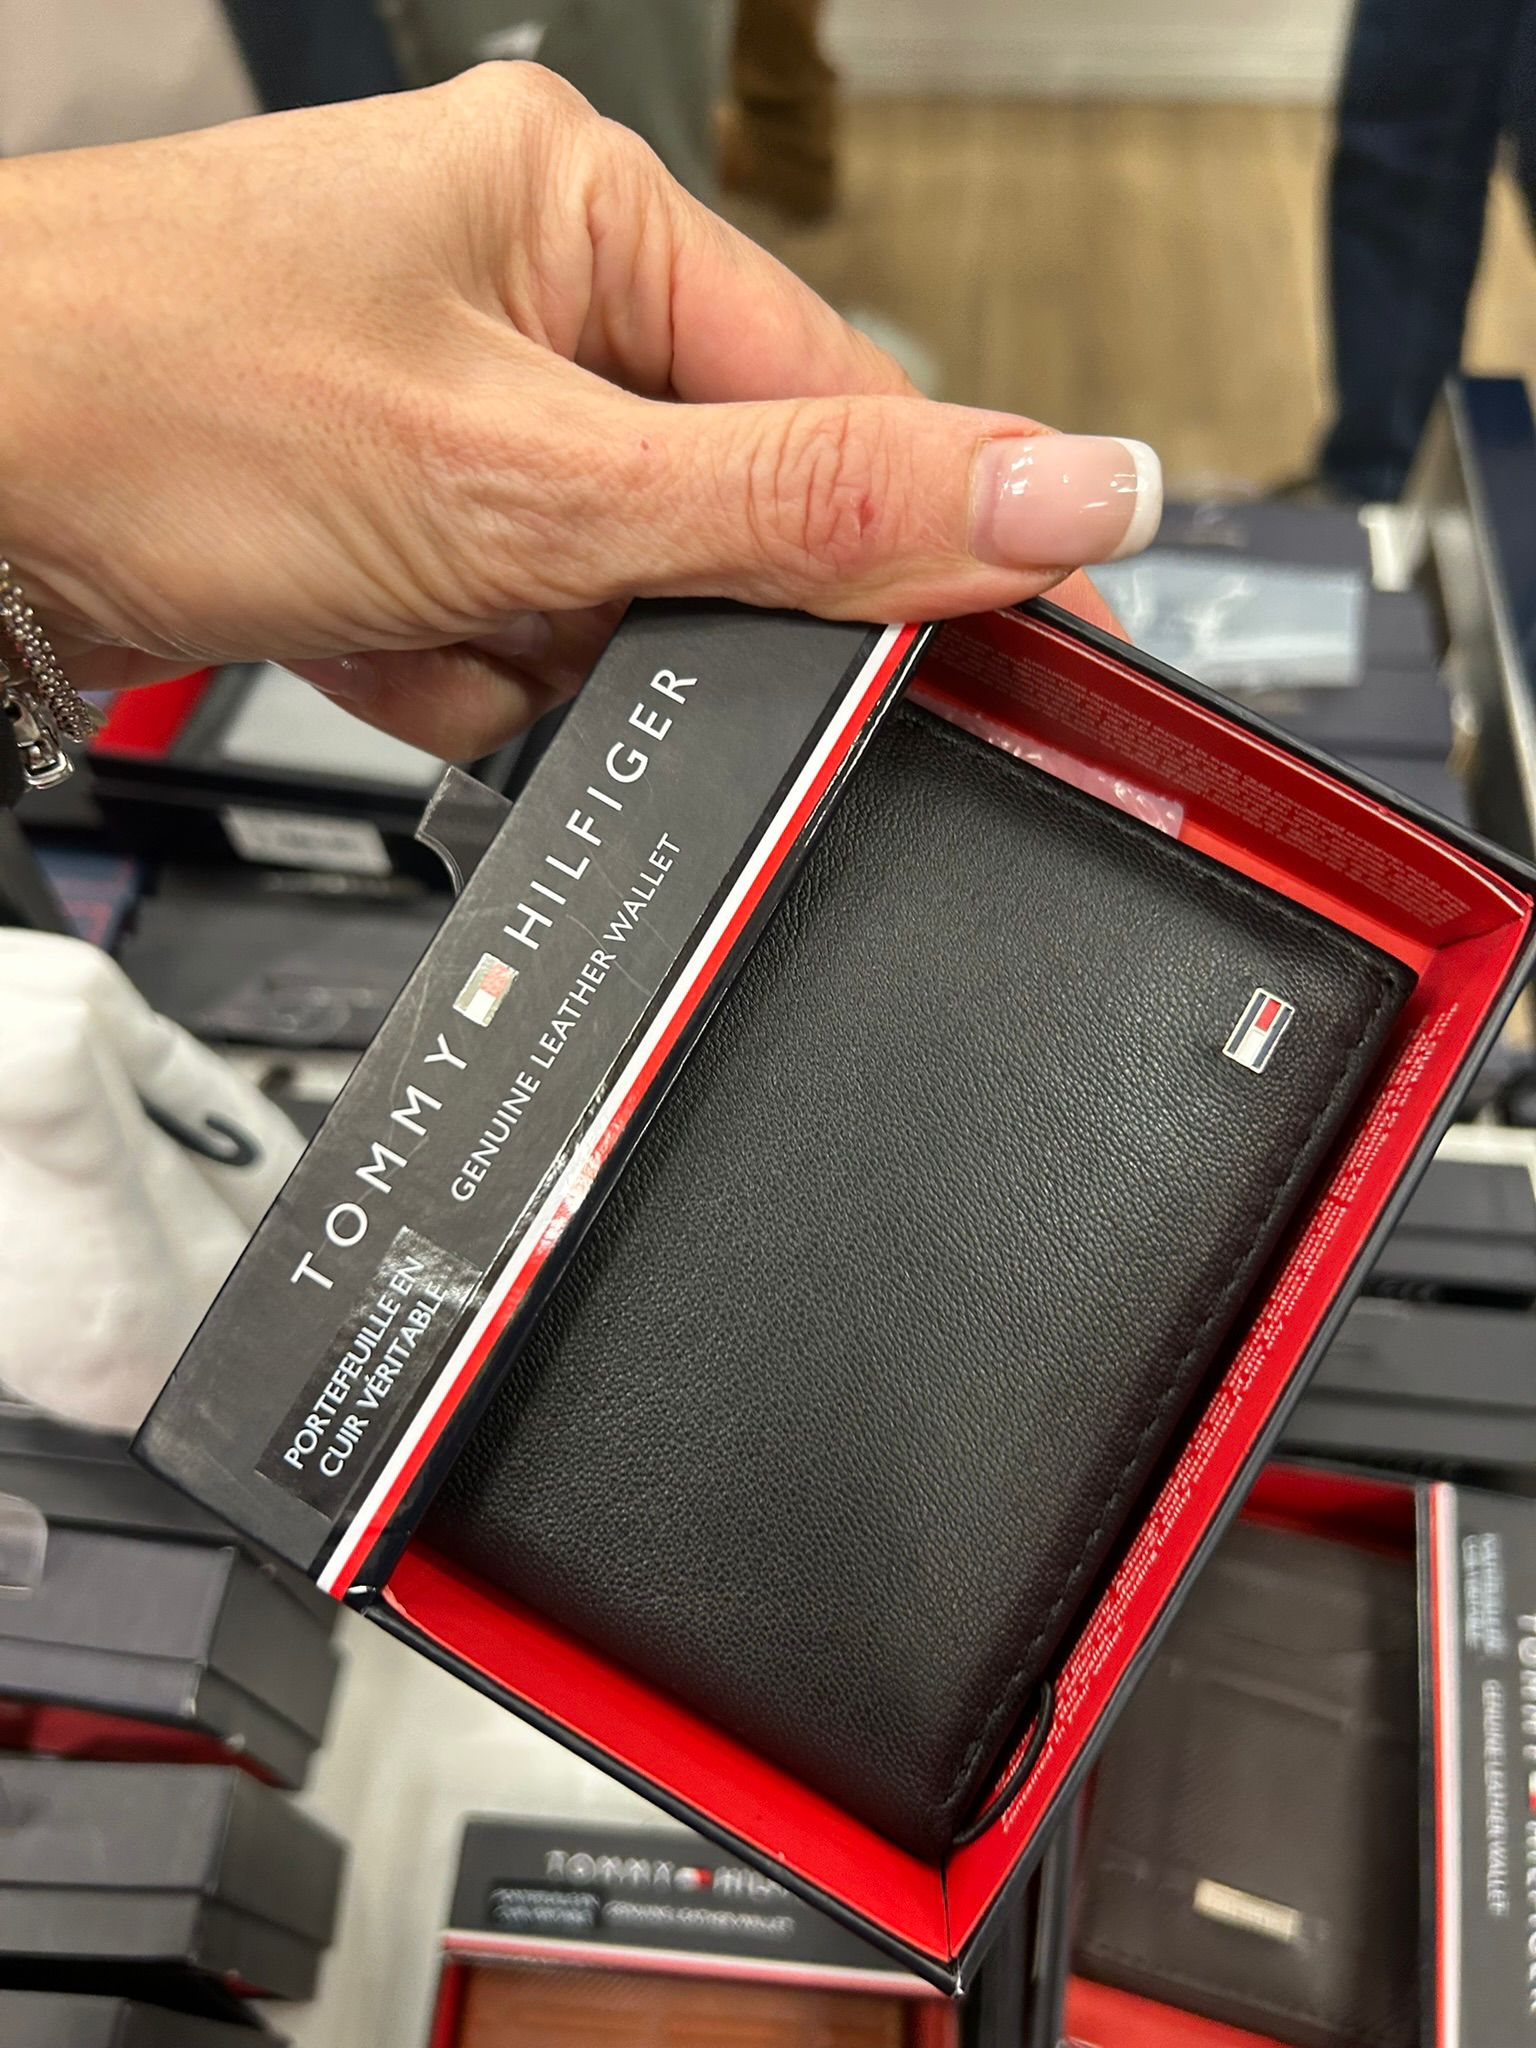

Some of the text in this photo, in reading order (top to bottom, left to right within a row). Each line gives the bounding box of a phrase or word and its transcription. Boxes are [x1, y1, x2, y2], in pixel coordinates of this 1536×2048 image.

[290, 1032, 468, 1290] TOMMY
[503, 668, 698, 950] HILFIGER
[451, 832, 680, 1203] GENUINE LEATHER WALLET
[283, 1255, 425, 1470] PORTEFEUILLE EN
[319, 1280, 449, 1478] CUIR VÉRITABLE
